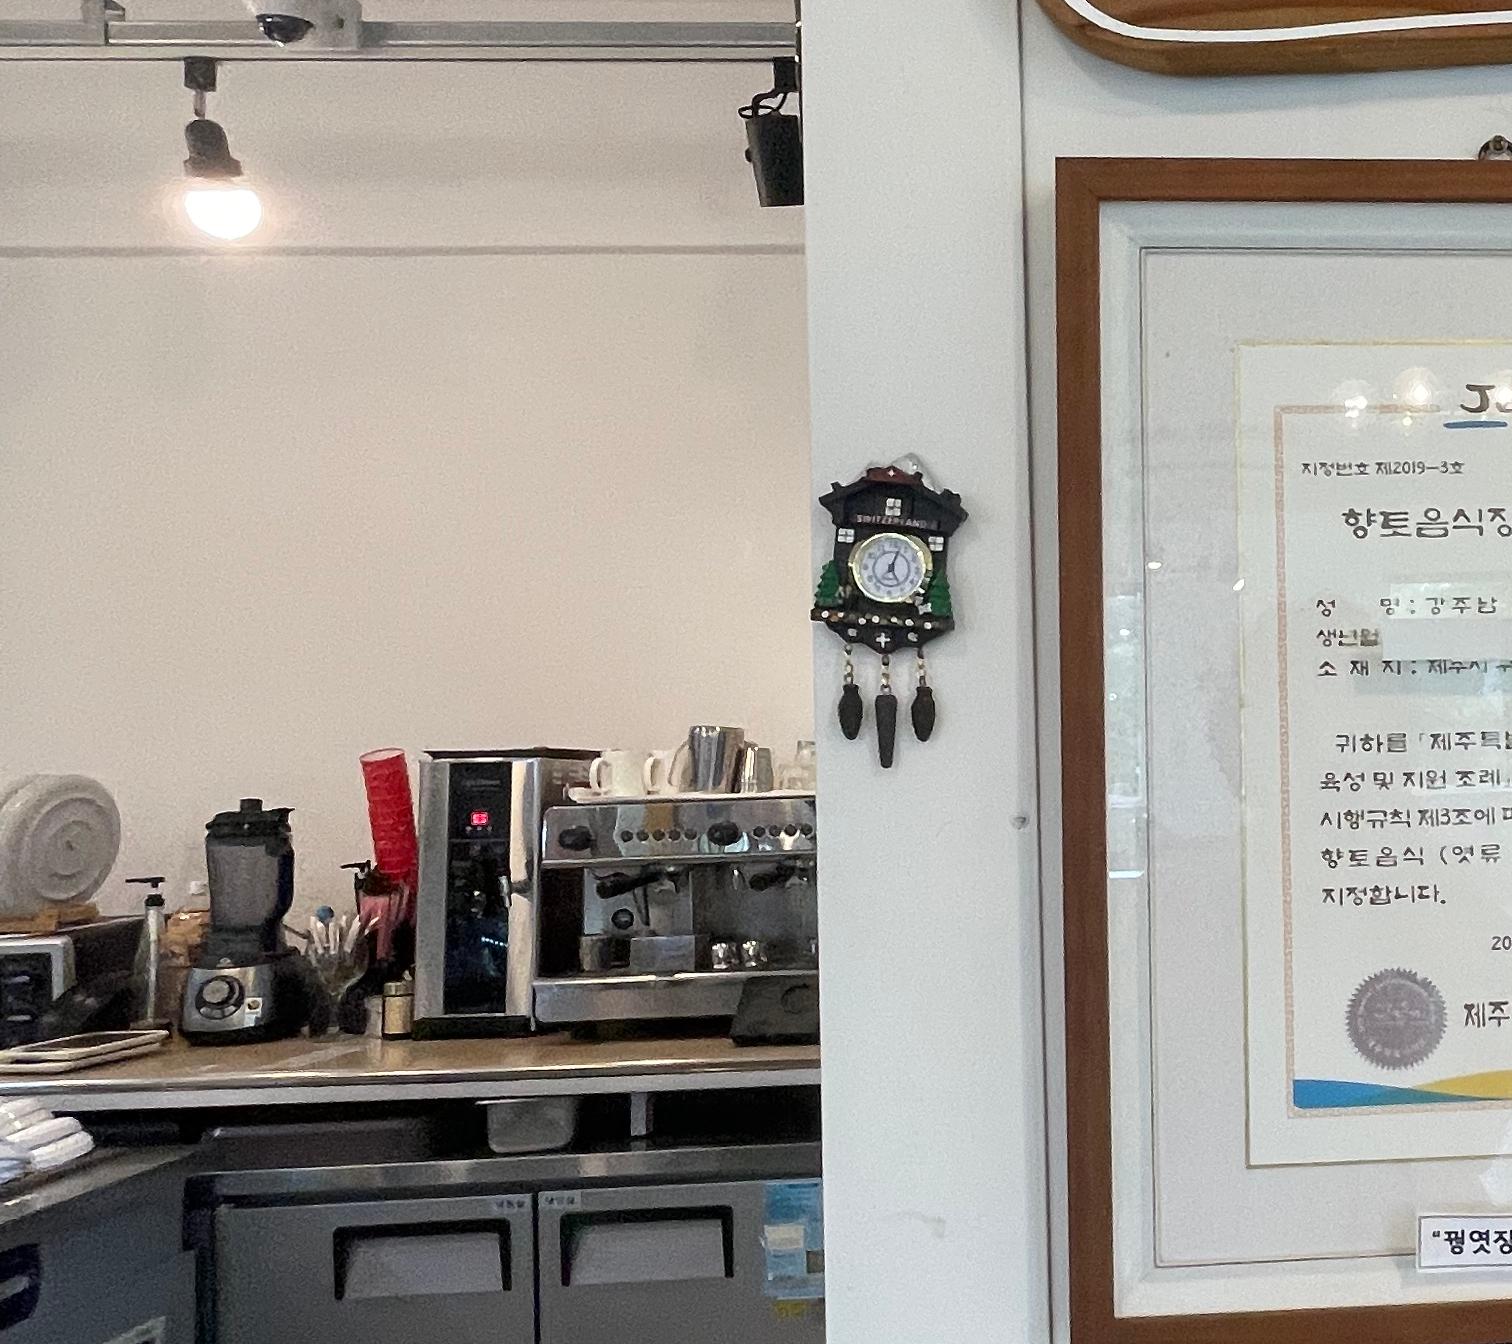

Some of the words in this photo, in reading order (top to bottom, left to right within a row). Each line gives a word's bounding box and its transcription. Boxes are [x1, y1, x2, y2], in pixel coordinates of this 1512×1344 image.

[1301, 460, 1369, 476] 지정번호
[1335, 732, 1407, 754] 귀하를
[1320, 770, 1367, 792] 육성
[1373, 770, 1394, 791] 및
[1403, 769, 1447, 790] 지원
[1320, 808, 1412, 829] 시행규칙
[1417, 806, 1496, 827] 제3조에
[1320, 845, 1426, 869] 향토음식
[1321, 883, 1446, 907] 지정합니다.
